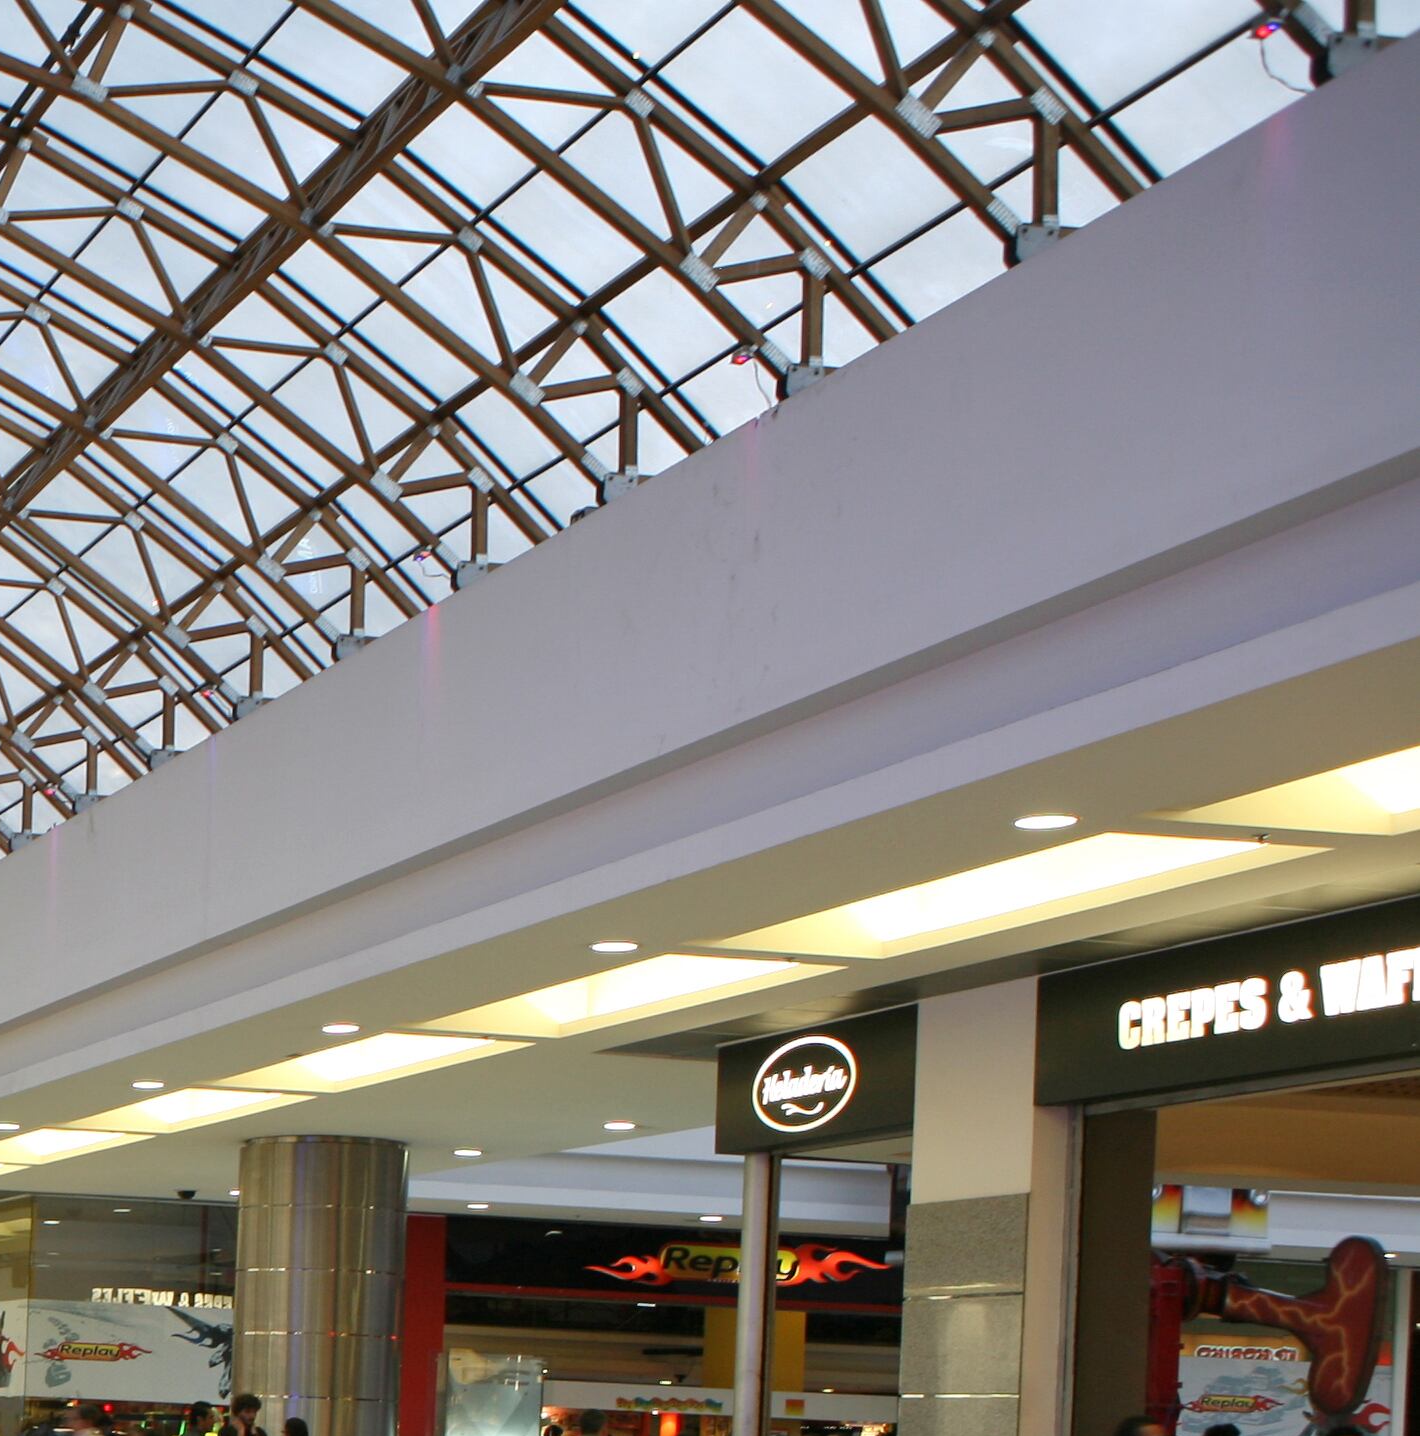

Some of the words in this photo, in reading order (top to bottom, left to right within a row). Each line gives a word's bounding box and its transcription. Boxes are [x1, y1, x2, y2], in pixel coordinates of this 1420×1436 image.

[1118, 977, 1268, 1050] CREPES
[1278, 970, 1312, 1023] &
[60, 1344, 120, 1358] Replay
